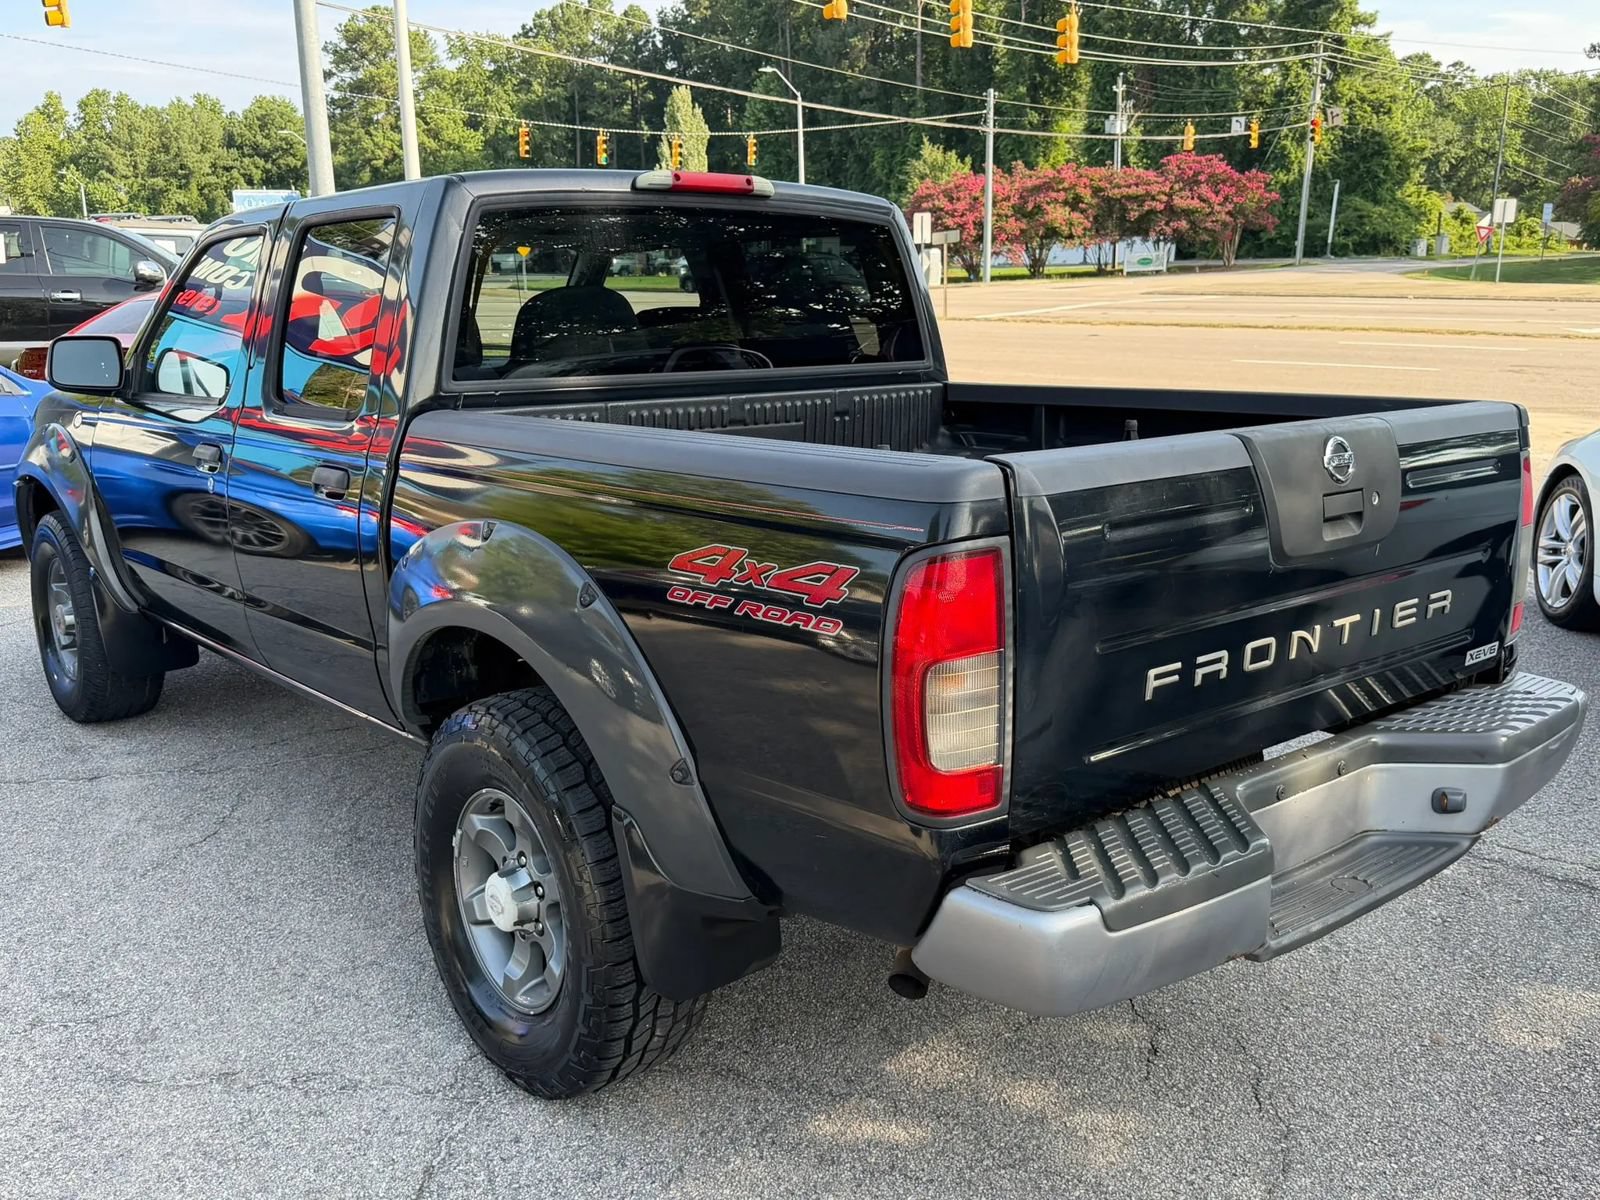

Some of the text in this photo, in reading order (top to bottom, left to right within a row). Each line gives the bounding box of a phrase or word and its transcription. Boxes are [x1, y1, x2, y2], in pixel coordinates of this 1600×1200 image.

[668, 544, 860, 608] 4x4
[667, 586, 843, 636] OFF ROAD
[1144, 589, 1452, 702] FRONTIER
